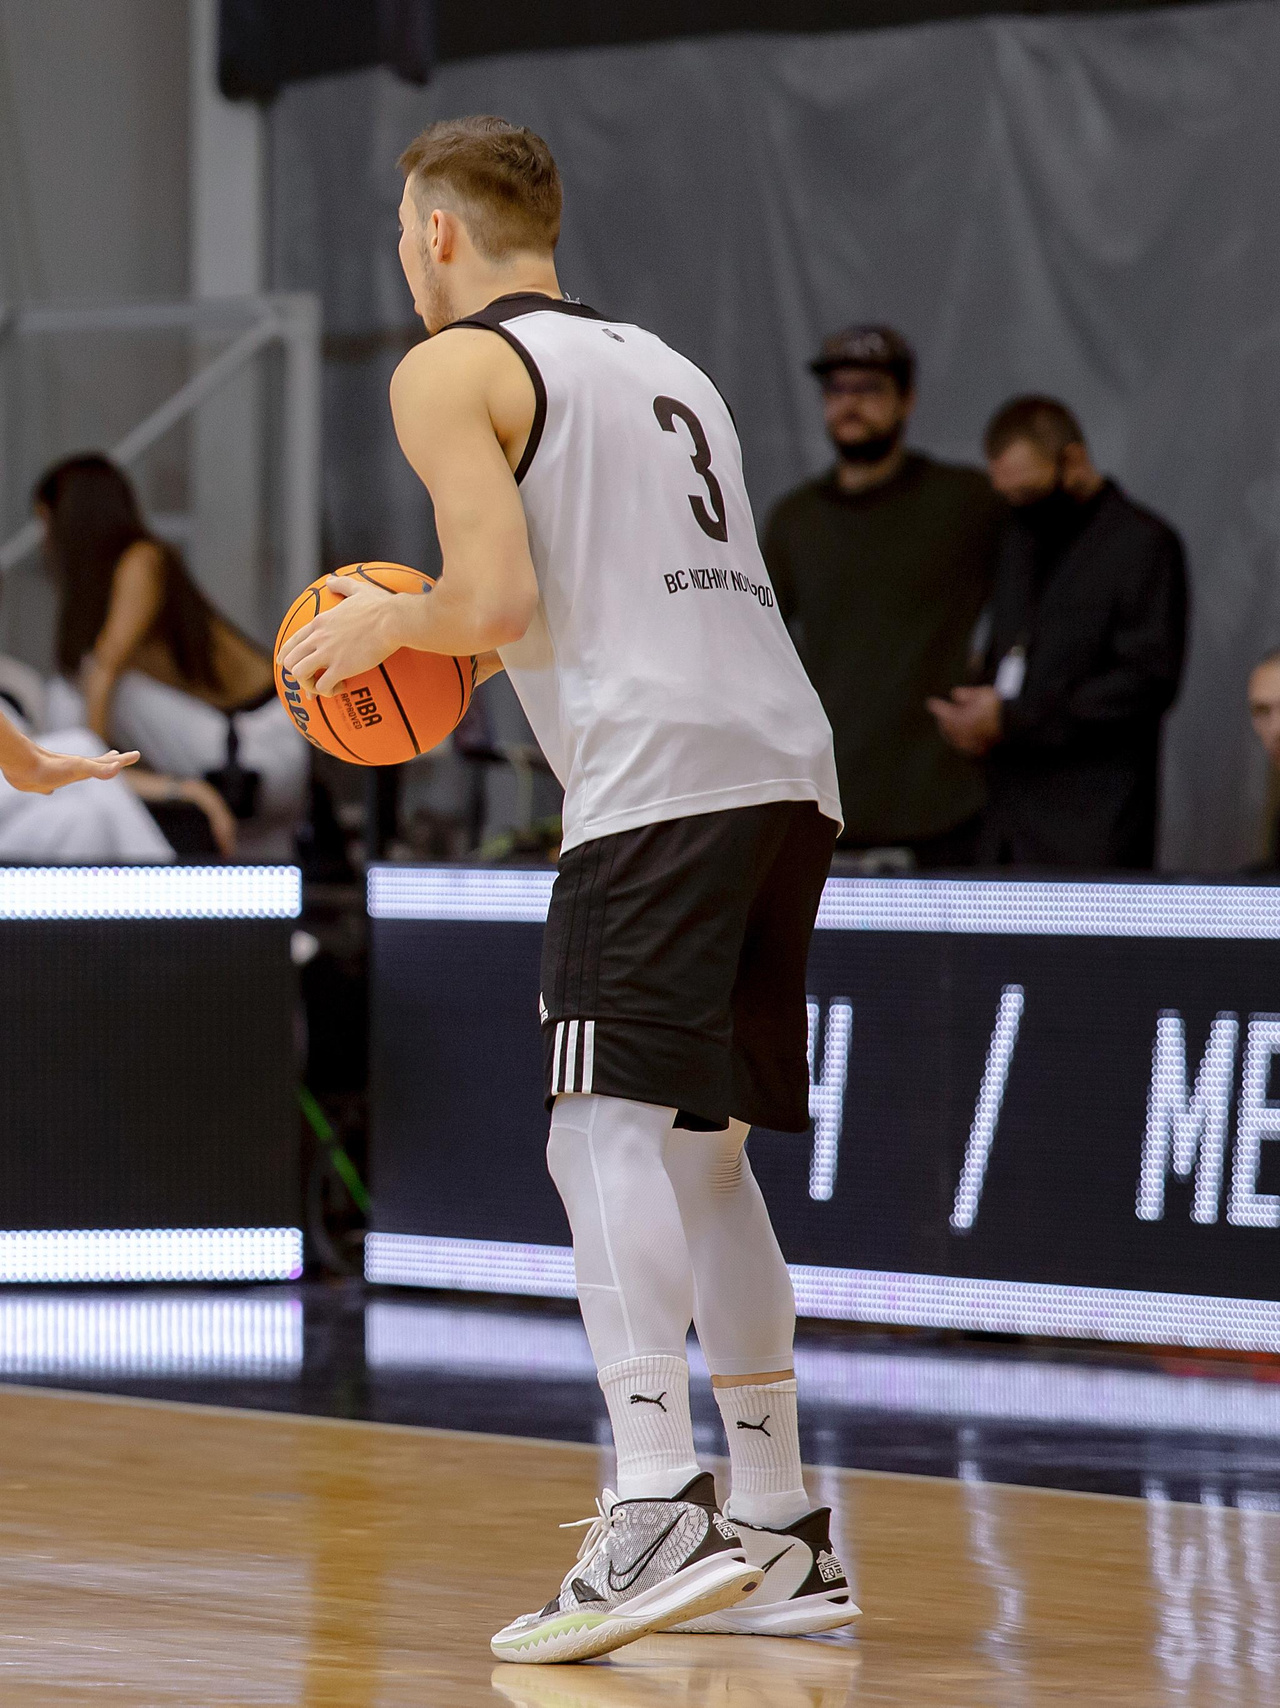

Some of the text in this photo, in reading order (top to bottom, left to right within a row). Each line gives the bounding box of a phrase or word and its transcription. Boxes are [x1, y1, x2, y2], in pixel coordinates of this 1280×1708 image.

[652, 394, 729, 543] 3
[663, 570, 689, 594] BC
[340, 692, 363, 730] APPROVED
[350, 686, 383, 728] FIBA
